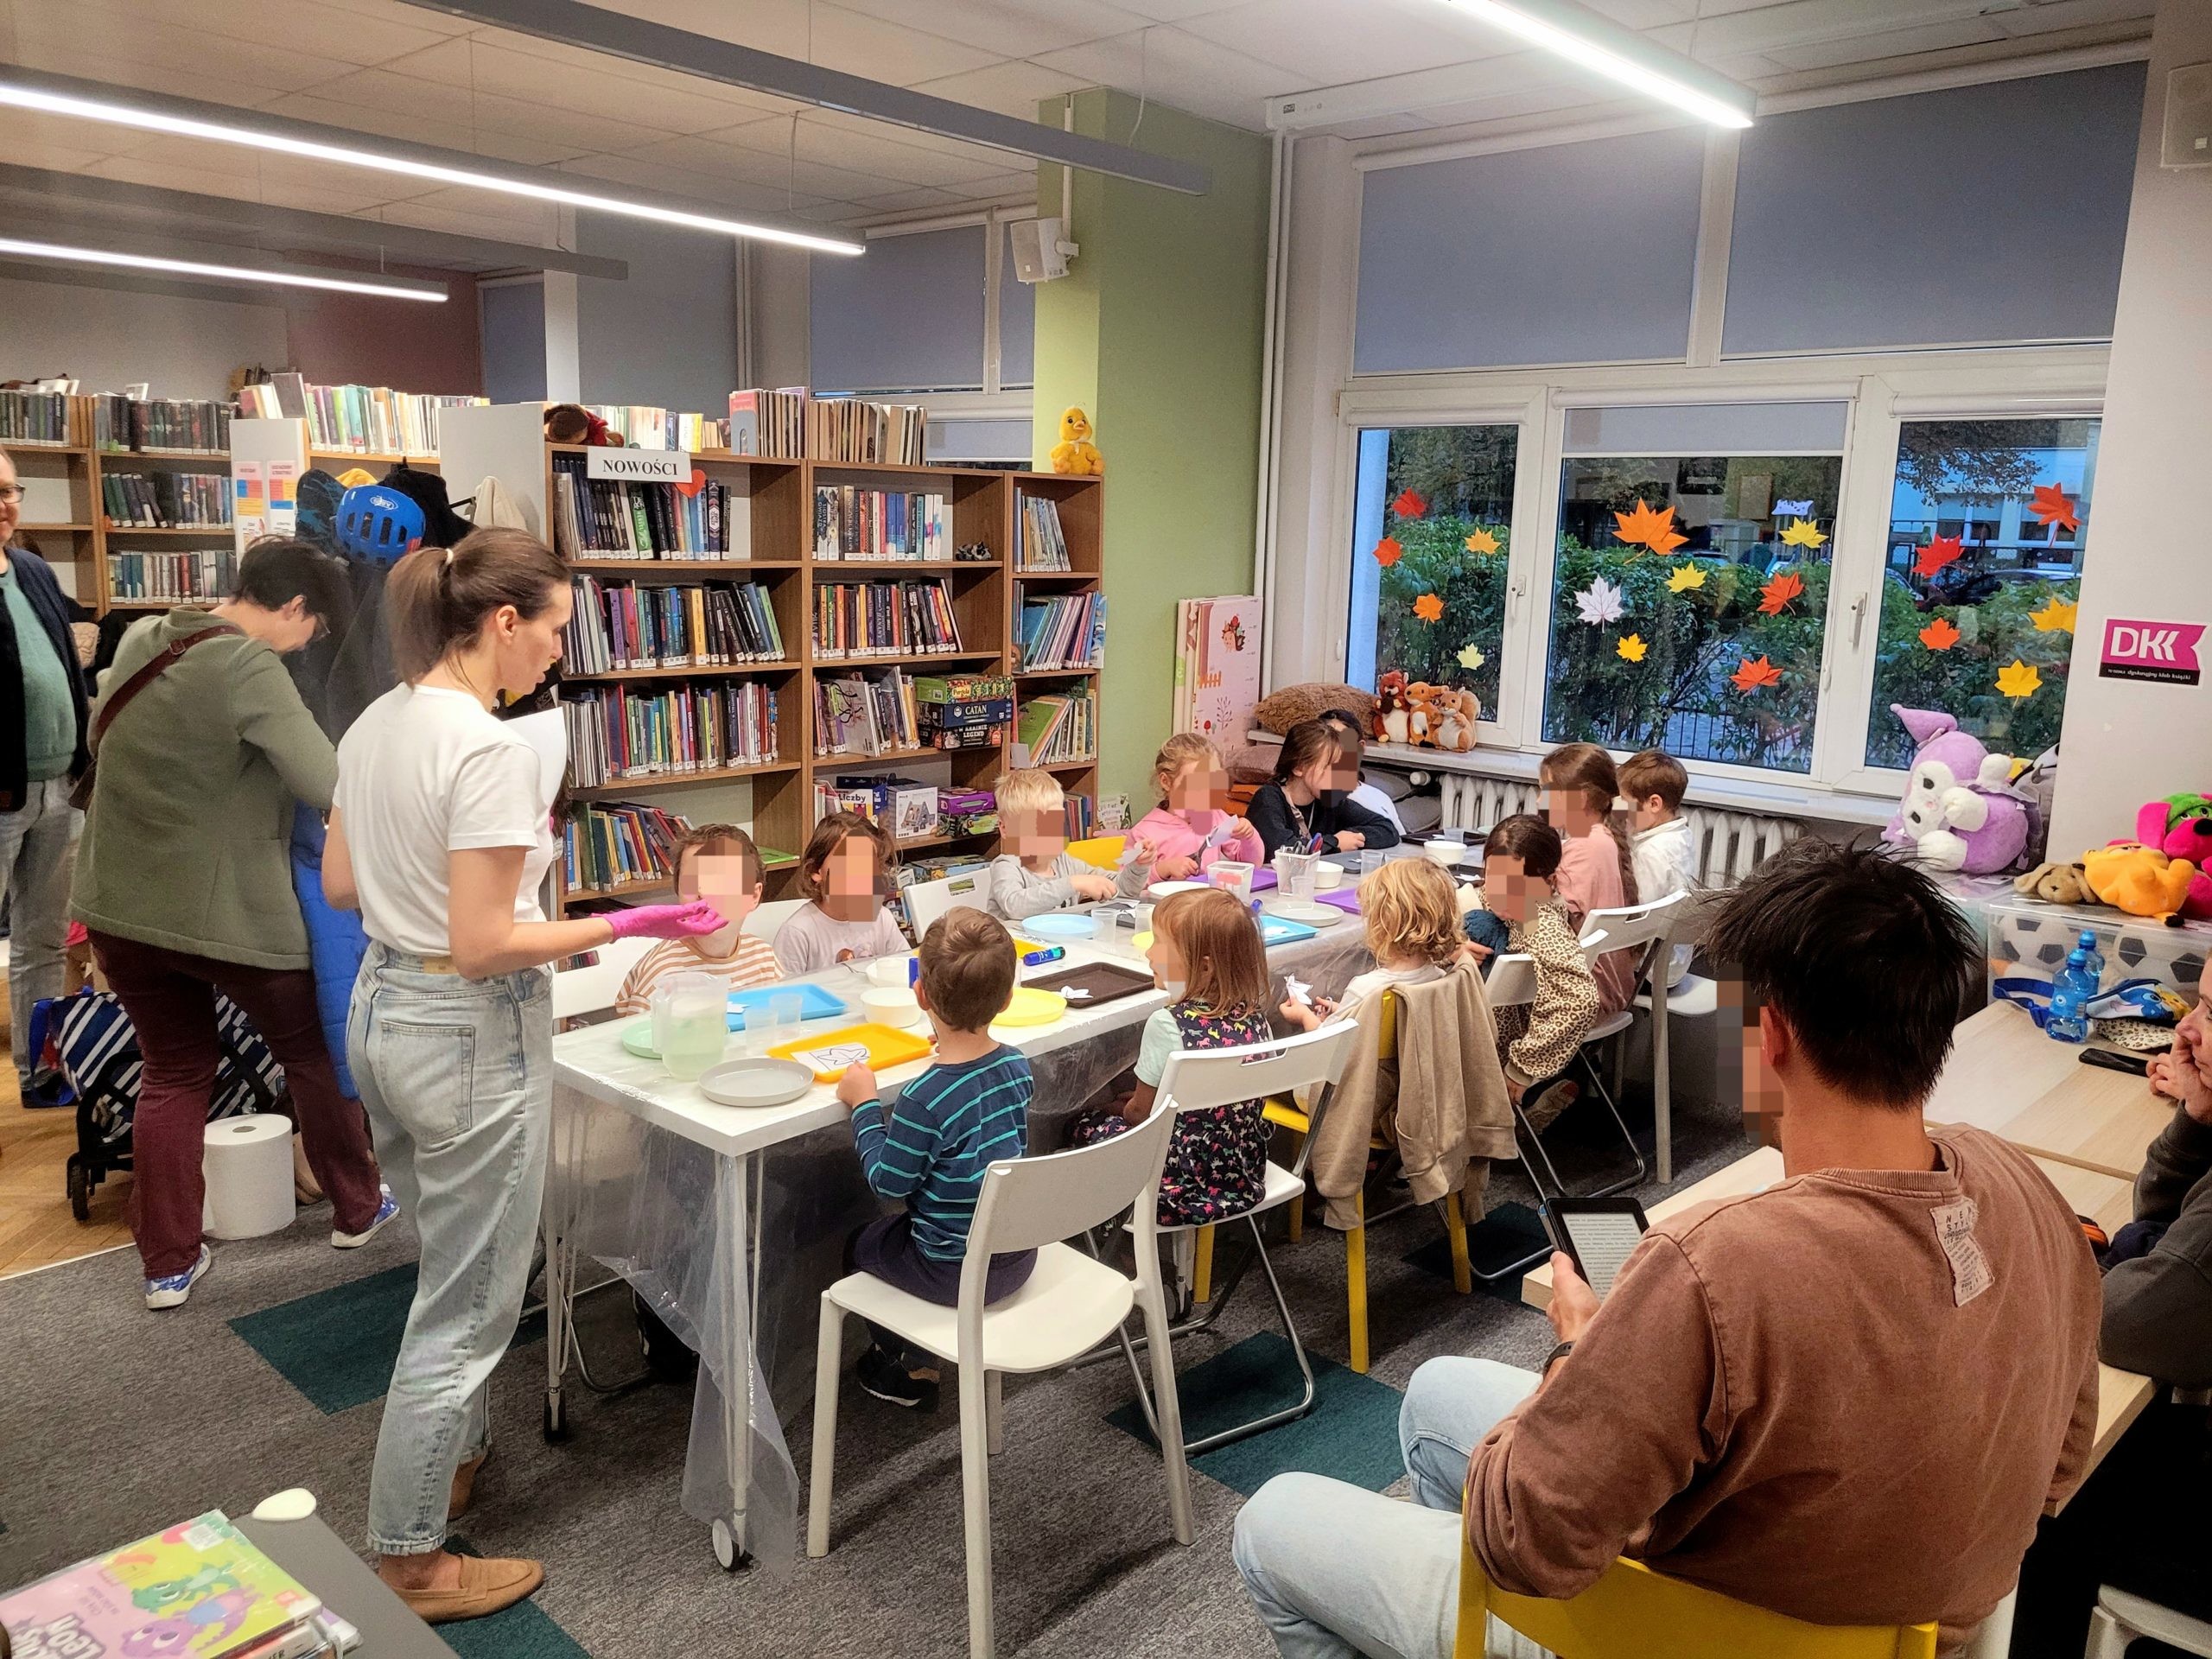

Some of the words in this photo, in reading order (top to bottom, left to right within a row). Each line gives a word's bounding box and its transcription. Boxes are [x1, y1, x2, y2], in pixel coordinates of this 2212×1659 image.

[603, 459, 677, 475] NOWOŚCI
[965, 704, 987, 715] CATAN
[839, 794, 866, 803] Liczby
